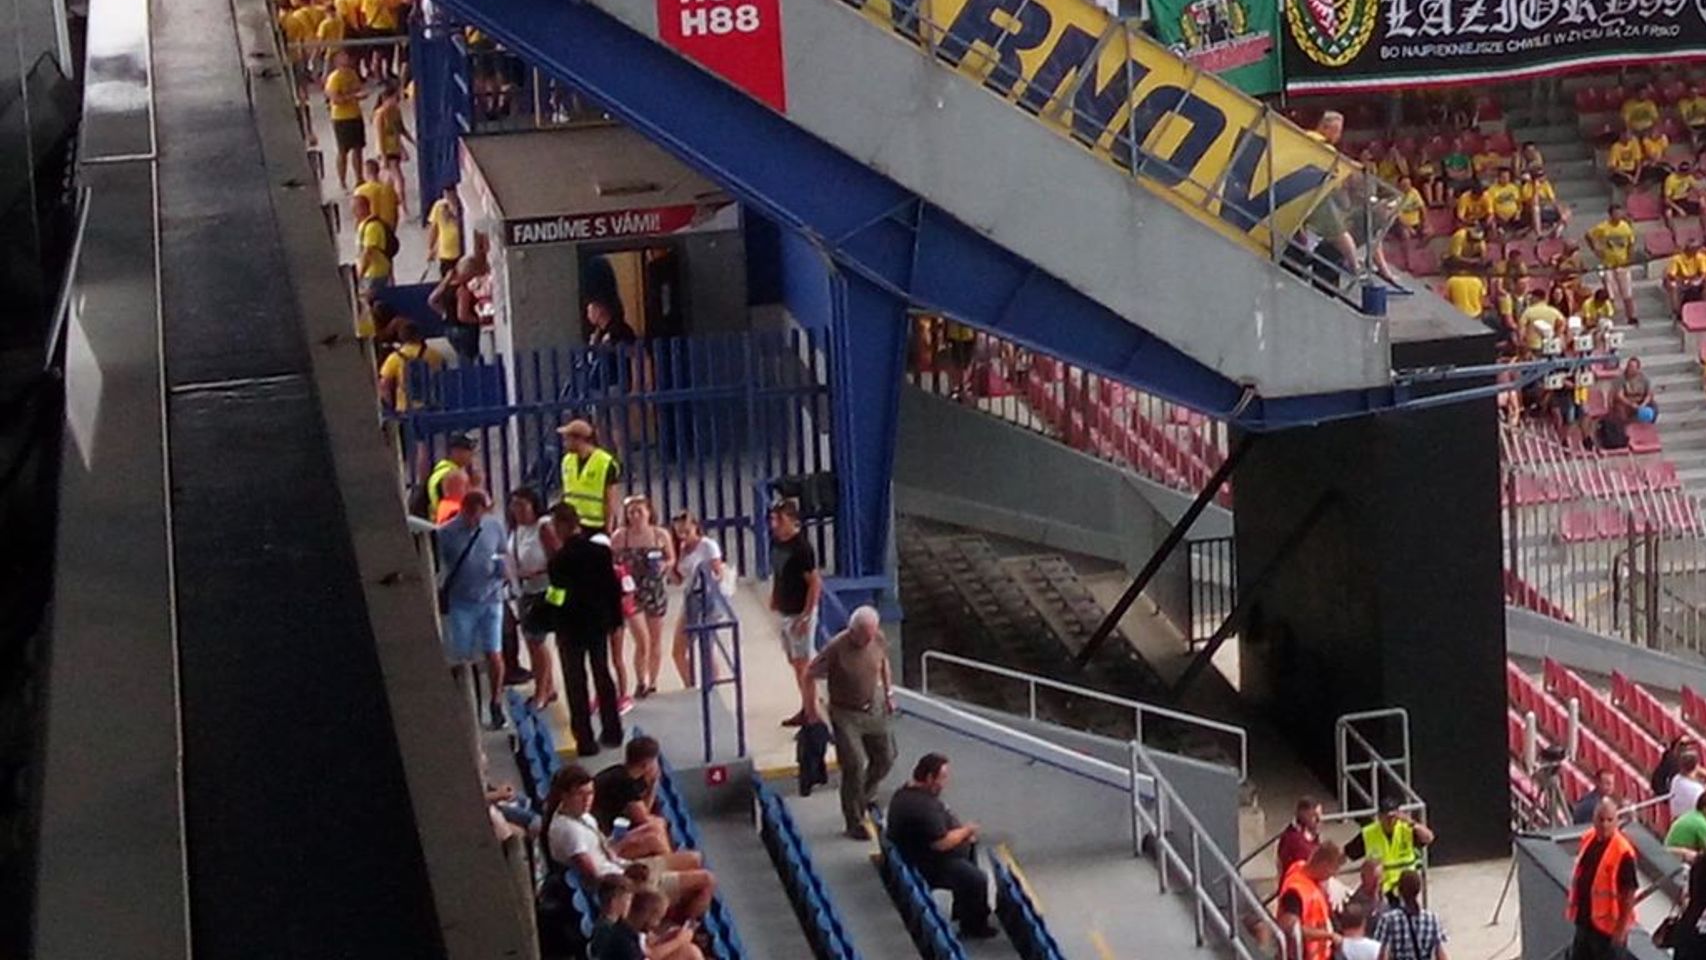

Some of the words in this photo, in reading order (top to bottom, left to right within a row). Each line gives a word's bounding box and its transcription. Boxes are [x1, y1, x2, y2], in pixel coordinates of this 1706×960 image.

[681, 4, 760, 36] H88
[1380, 45, 1400, 59] BO
[513, 217, 592, 244] FANDÍME
[595, 221, 607, 235] S
[611, 210, 661, 235] VÁMI!
